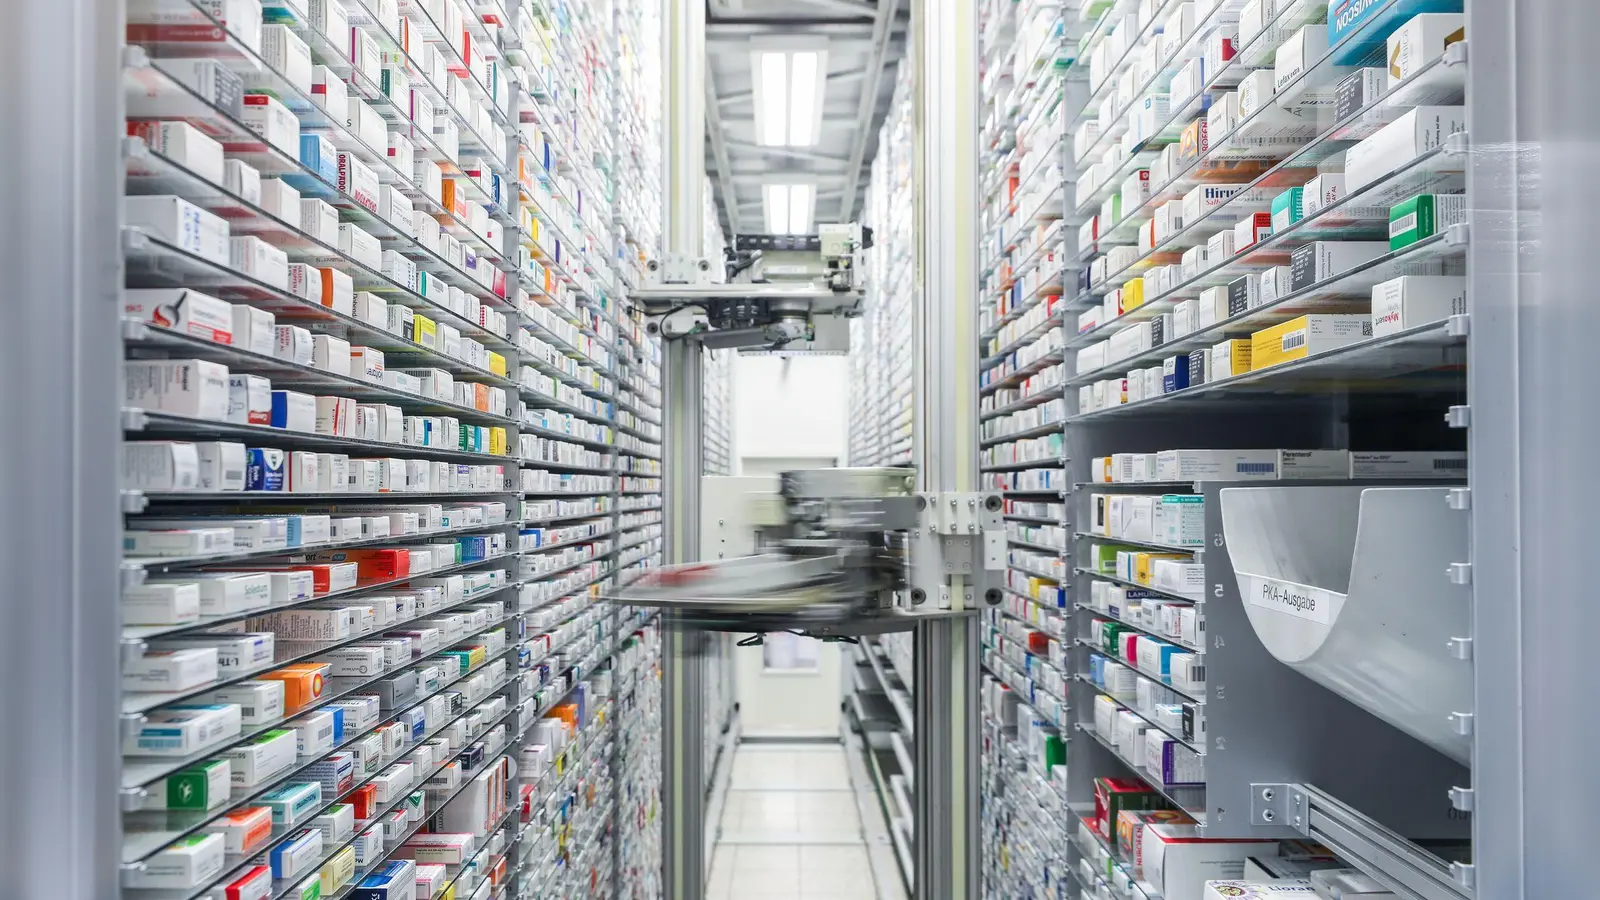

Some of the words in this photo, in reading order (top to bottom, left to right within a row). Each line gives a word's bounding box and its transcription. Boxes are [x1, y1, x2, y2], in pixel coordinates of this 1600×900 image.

[1336, 0, 1379, 34] AVISCON
[1277, 72, 1291, 88] Lefax
[505, 509, 512, 518] 7
[505, 571, 511, 579] 5
[1262, 584, 1316, 611] PKA-Ausgabe
[505, 631, 511, 640] 3
[505, 662, 511, 671] 2
